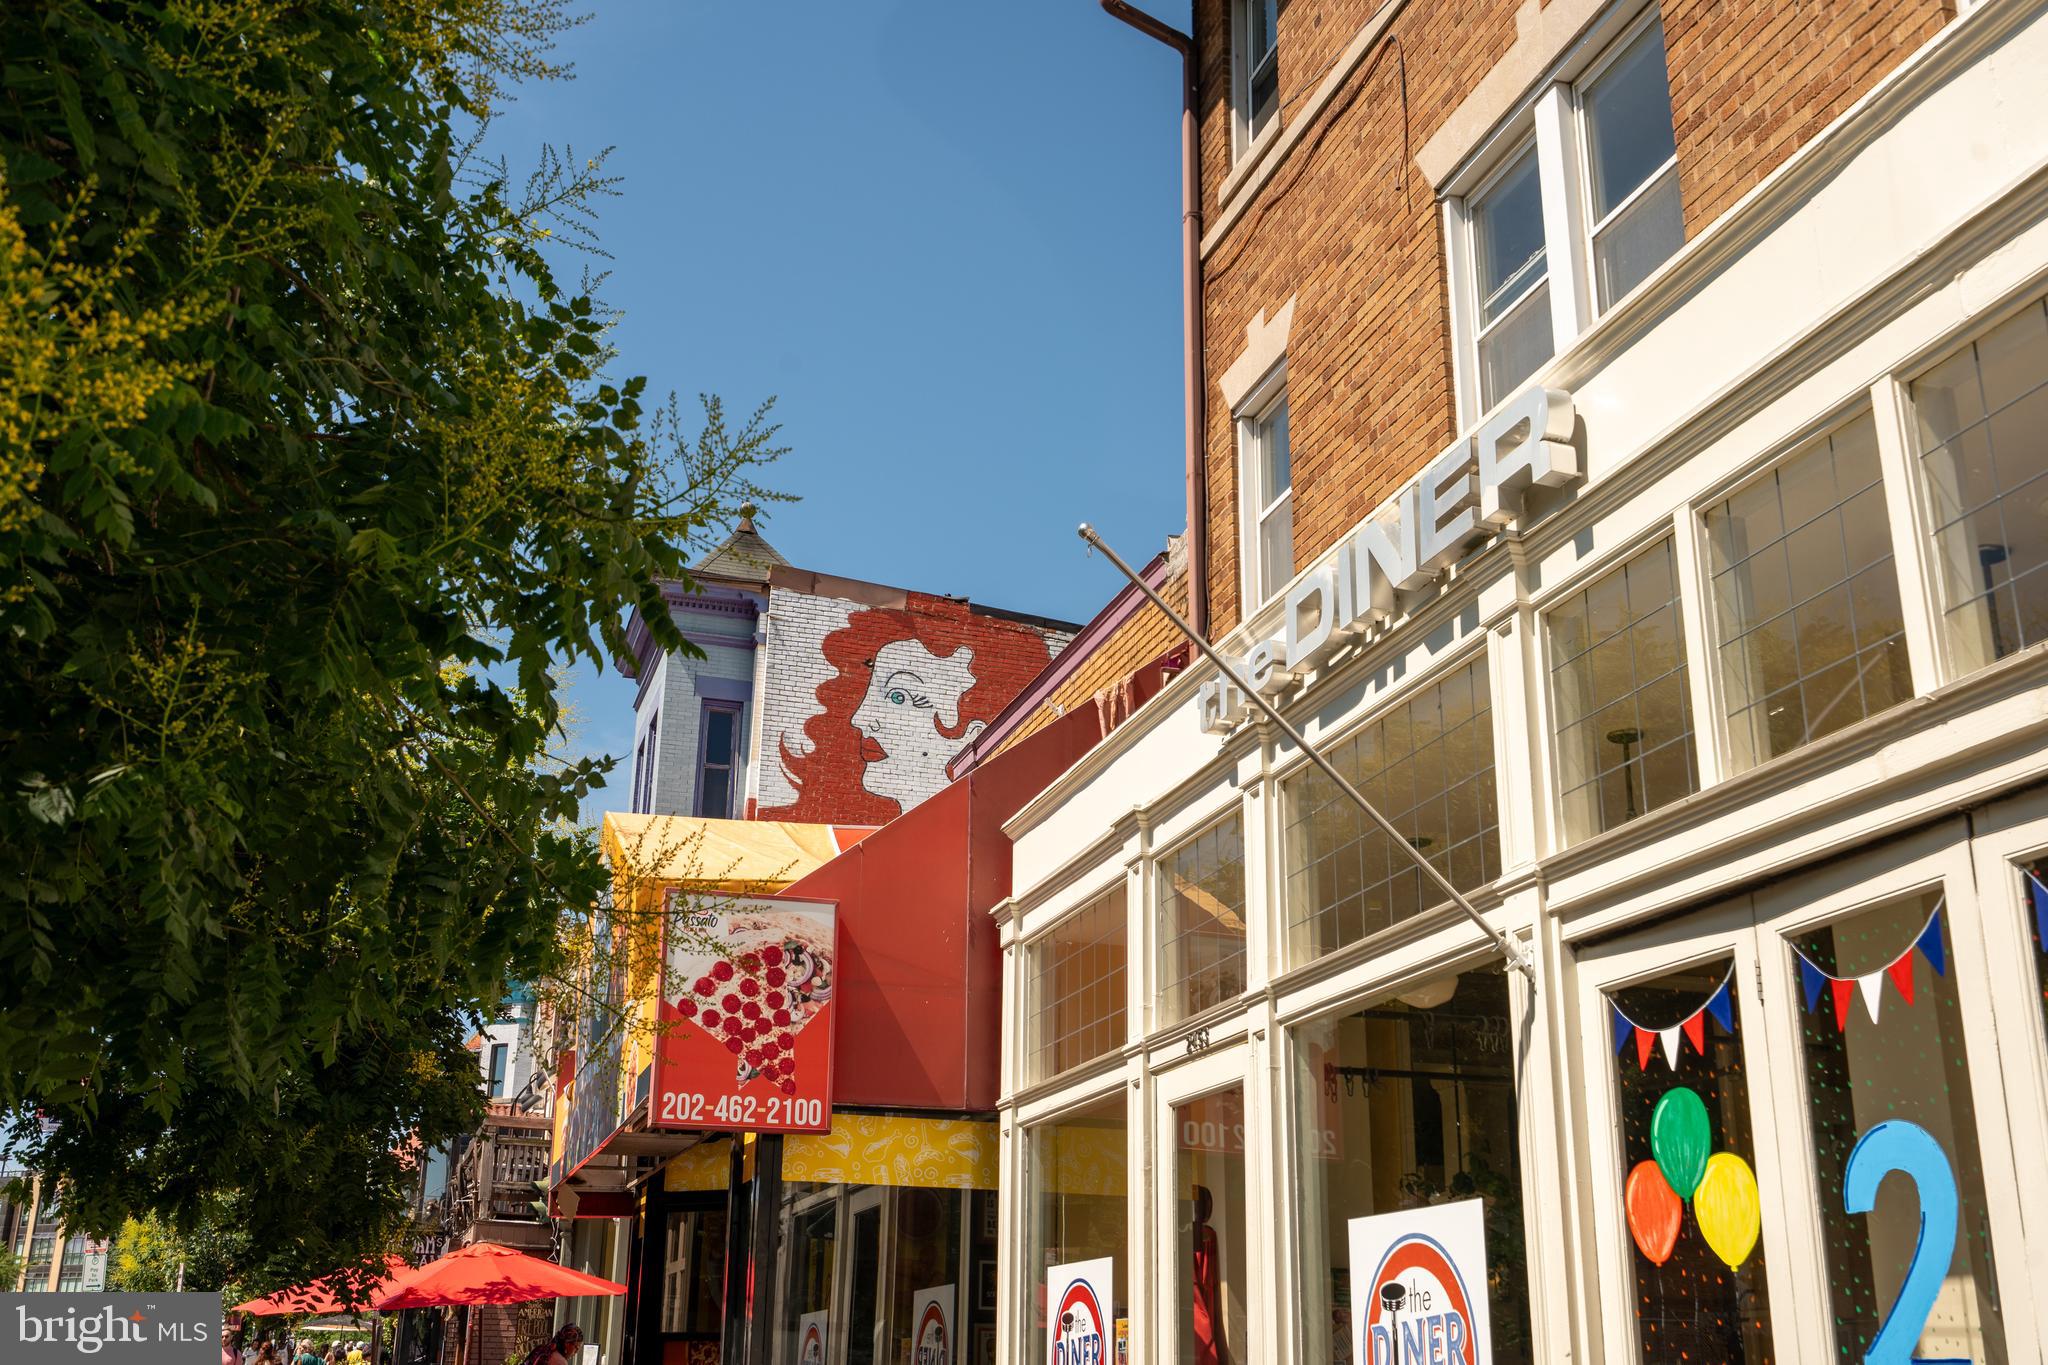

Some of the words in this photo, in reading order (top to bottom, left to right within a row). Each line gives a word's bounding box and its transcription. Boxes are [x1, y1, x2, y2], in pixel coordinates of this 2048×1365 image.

[1285, 385, 1576, 673] DINER
[661, 1091, 822, 1126] 202-462-2100
[1408, 1278, 1432, 1313] the
